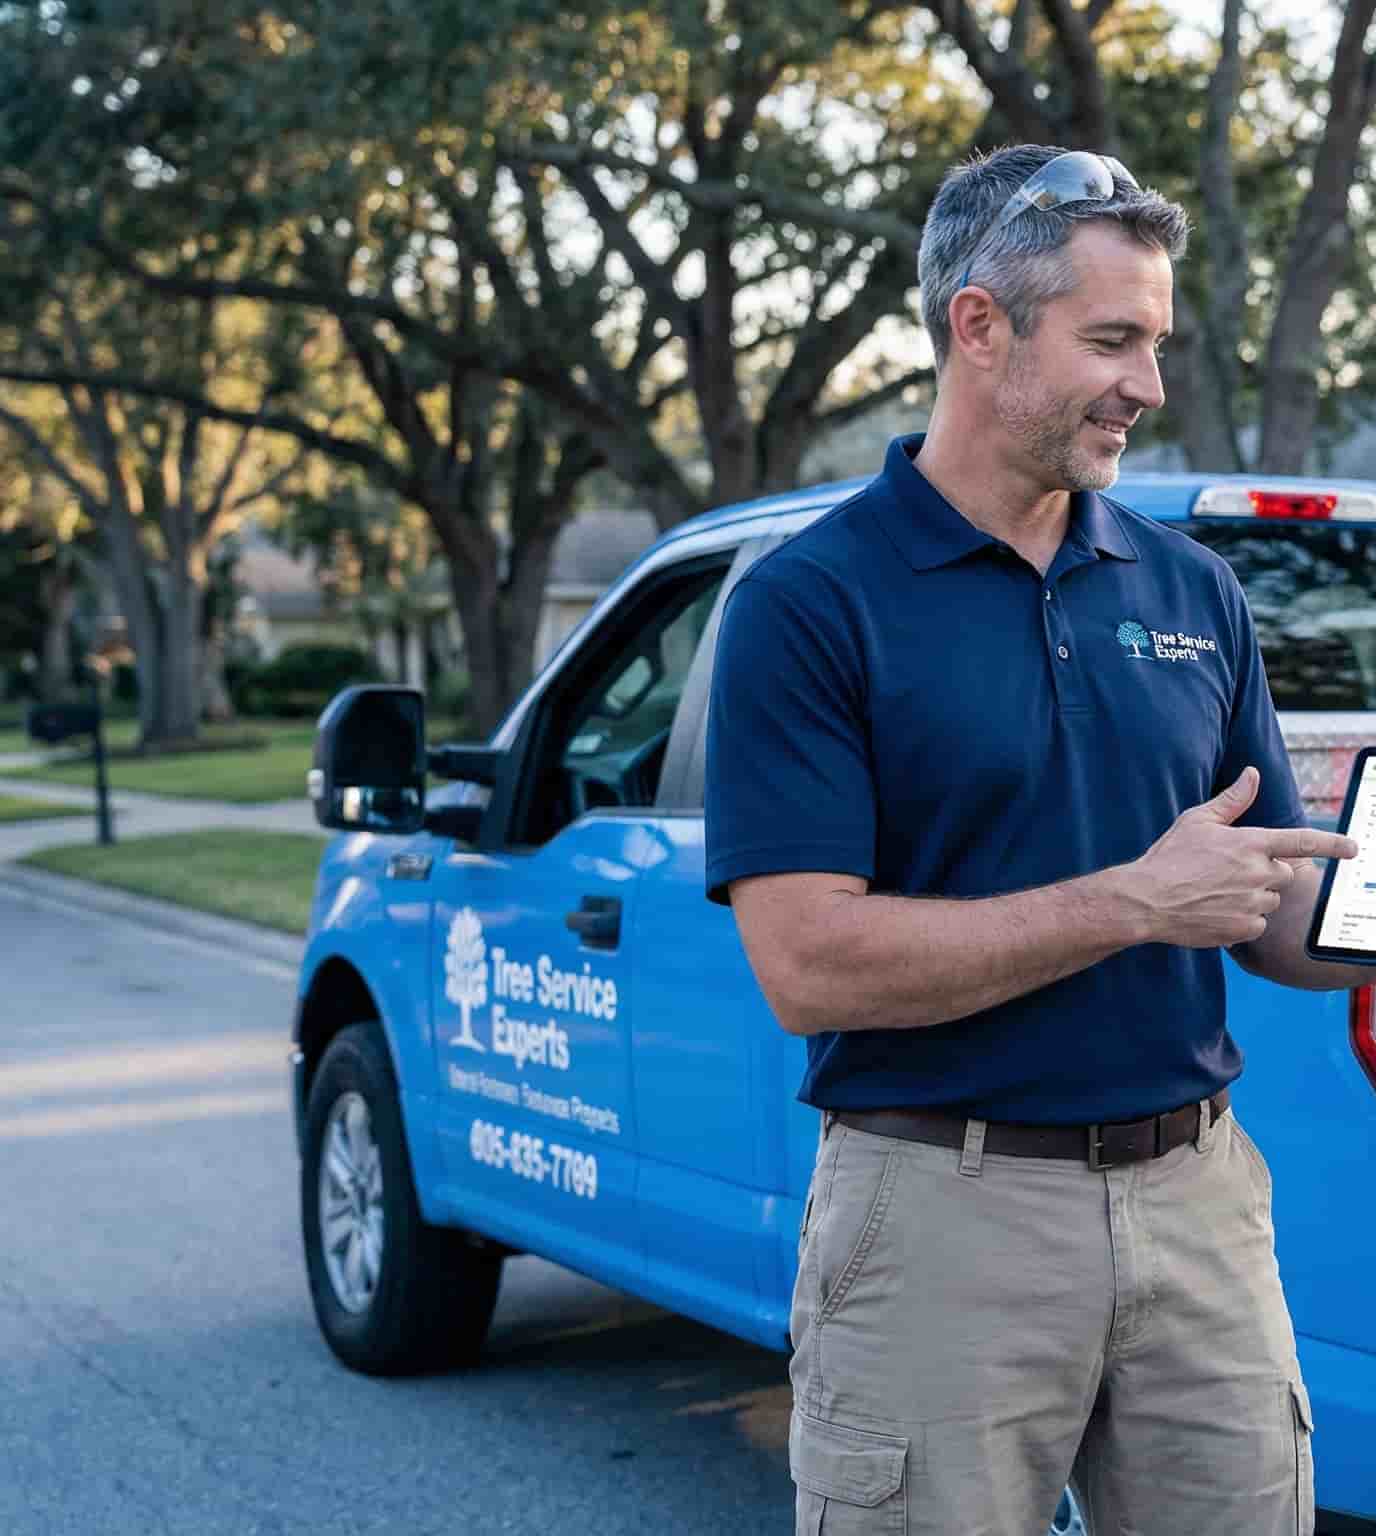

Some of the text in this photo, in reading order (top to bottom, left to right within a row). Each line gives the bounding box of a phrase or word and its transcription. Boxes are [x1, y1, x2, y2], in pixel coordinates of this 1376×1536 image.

[1150, 631, 1176, 645] Tree
[1155, 645, 1198, 662] Experts
[491, 947, 617, 1020] Tree Service
[491, 1003, 569, 1070] Experts
